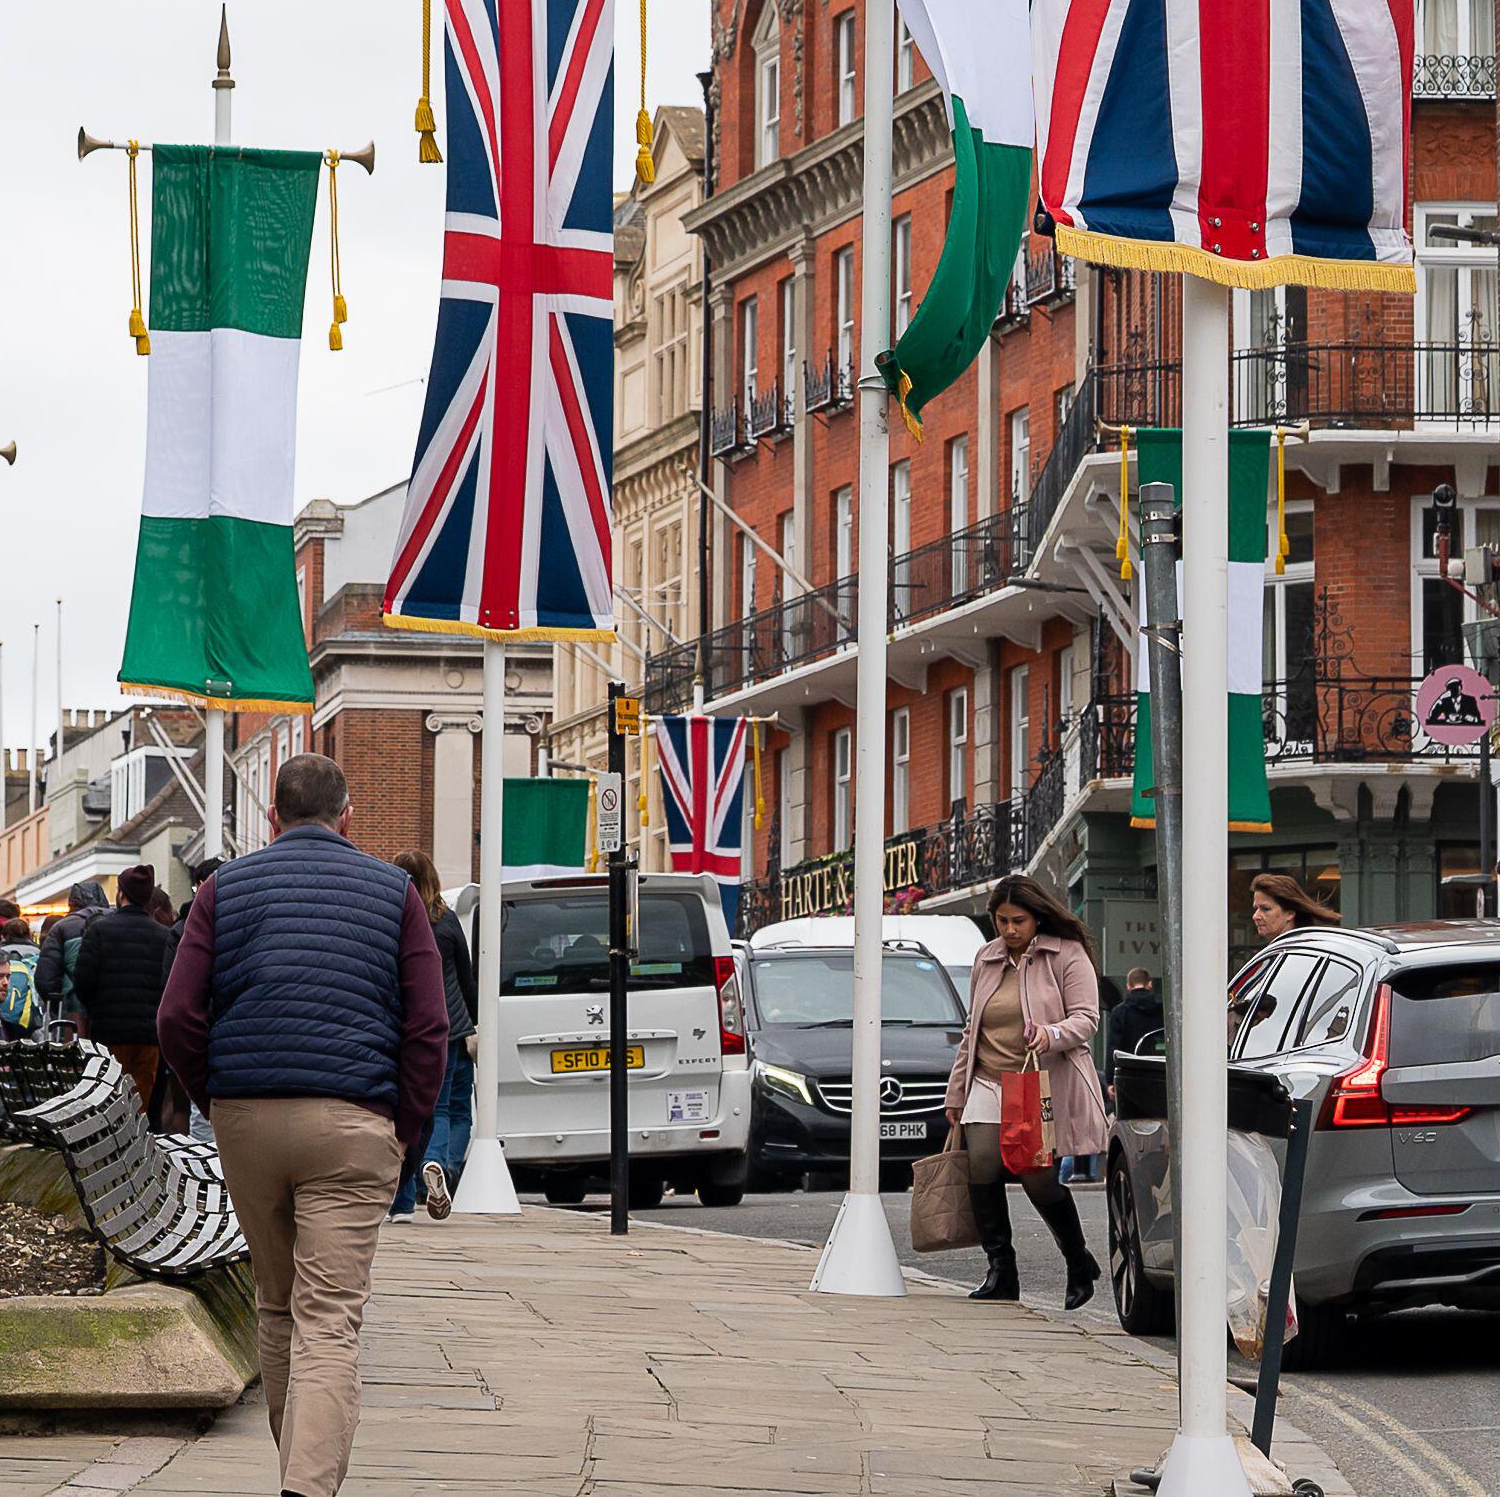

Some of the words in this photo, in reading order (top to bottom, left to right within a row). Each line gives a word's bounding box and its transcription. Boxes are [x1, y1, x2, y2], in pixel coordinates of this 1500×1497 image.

[779, 867, 833, 921] HARTE
[835, 862, 850, 906] &
[1124, 921, 1157, 933] THE
[1118, 940, 1161, 955] IVY
[563, 1052, 600, 1069] SF10
[678, 1057, 717, 1065] EXPERT
[899, 1124, 925, 1137] PHK
[1398, 1131, 1438, 1144] V60
